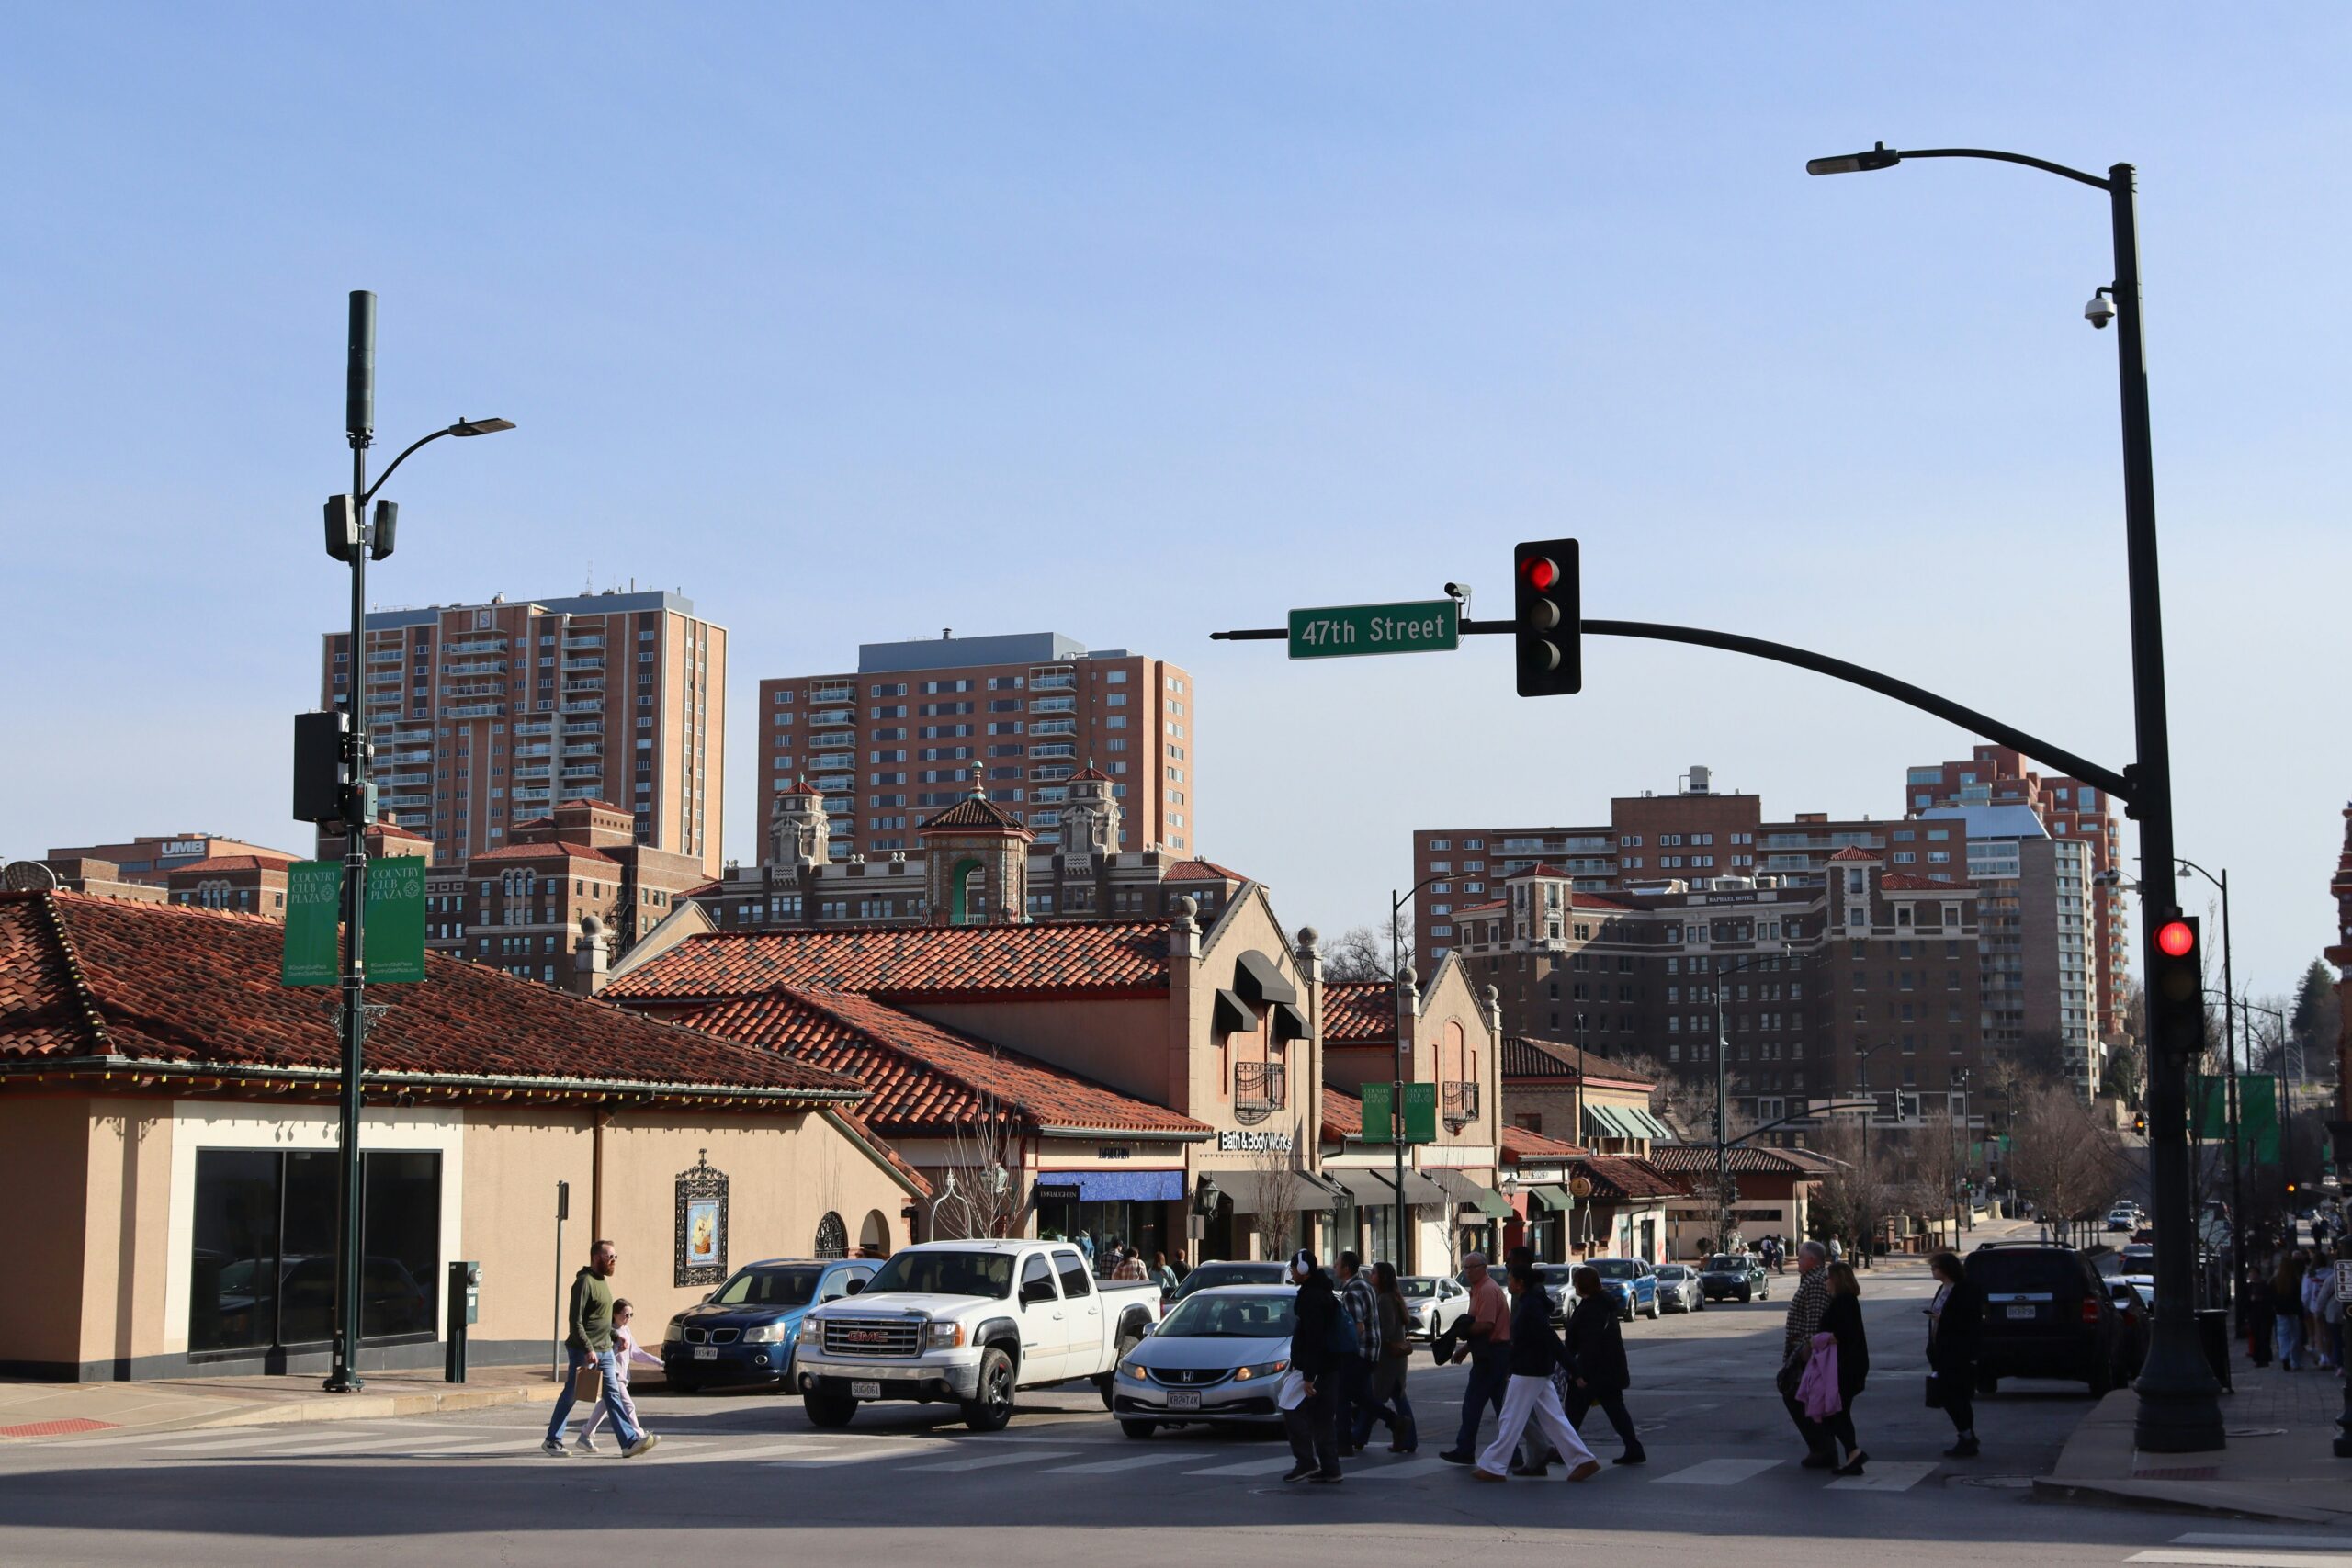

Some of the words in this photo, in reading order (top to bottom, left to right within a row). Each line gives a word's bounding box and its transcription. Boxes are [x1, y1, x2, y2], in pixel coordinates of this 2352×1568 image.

[1302, 619, 1355, 645] 47th
[1369, 614, 1444, 642] Street
[161, 840, 206, 854] UMB
[292, 871, 335, 883] COUNTRY
[372, 867, 419, 878] COUNTRY
[292, 883, 316, 893] CLUB
[371, 879, 398, 890] CLUB
[291, 893, 320, 904] PLAZA
[371, 889, 402, 901] PLAZA
[1220, 1131, 1241, 1151] Bath
[1241, 1131, 1249, 1151] &
[1249, 1131, 1268, 1154] Body
[1268, 1131, 1293, 1151] Works
[848, 1330, 888, 1342] GMC
